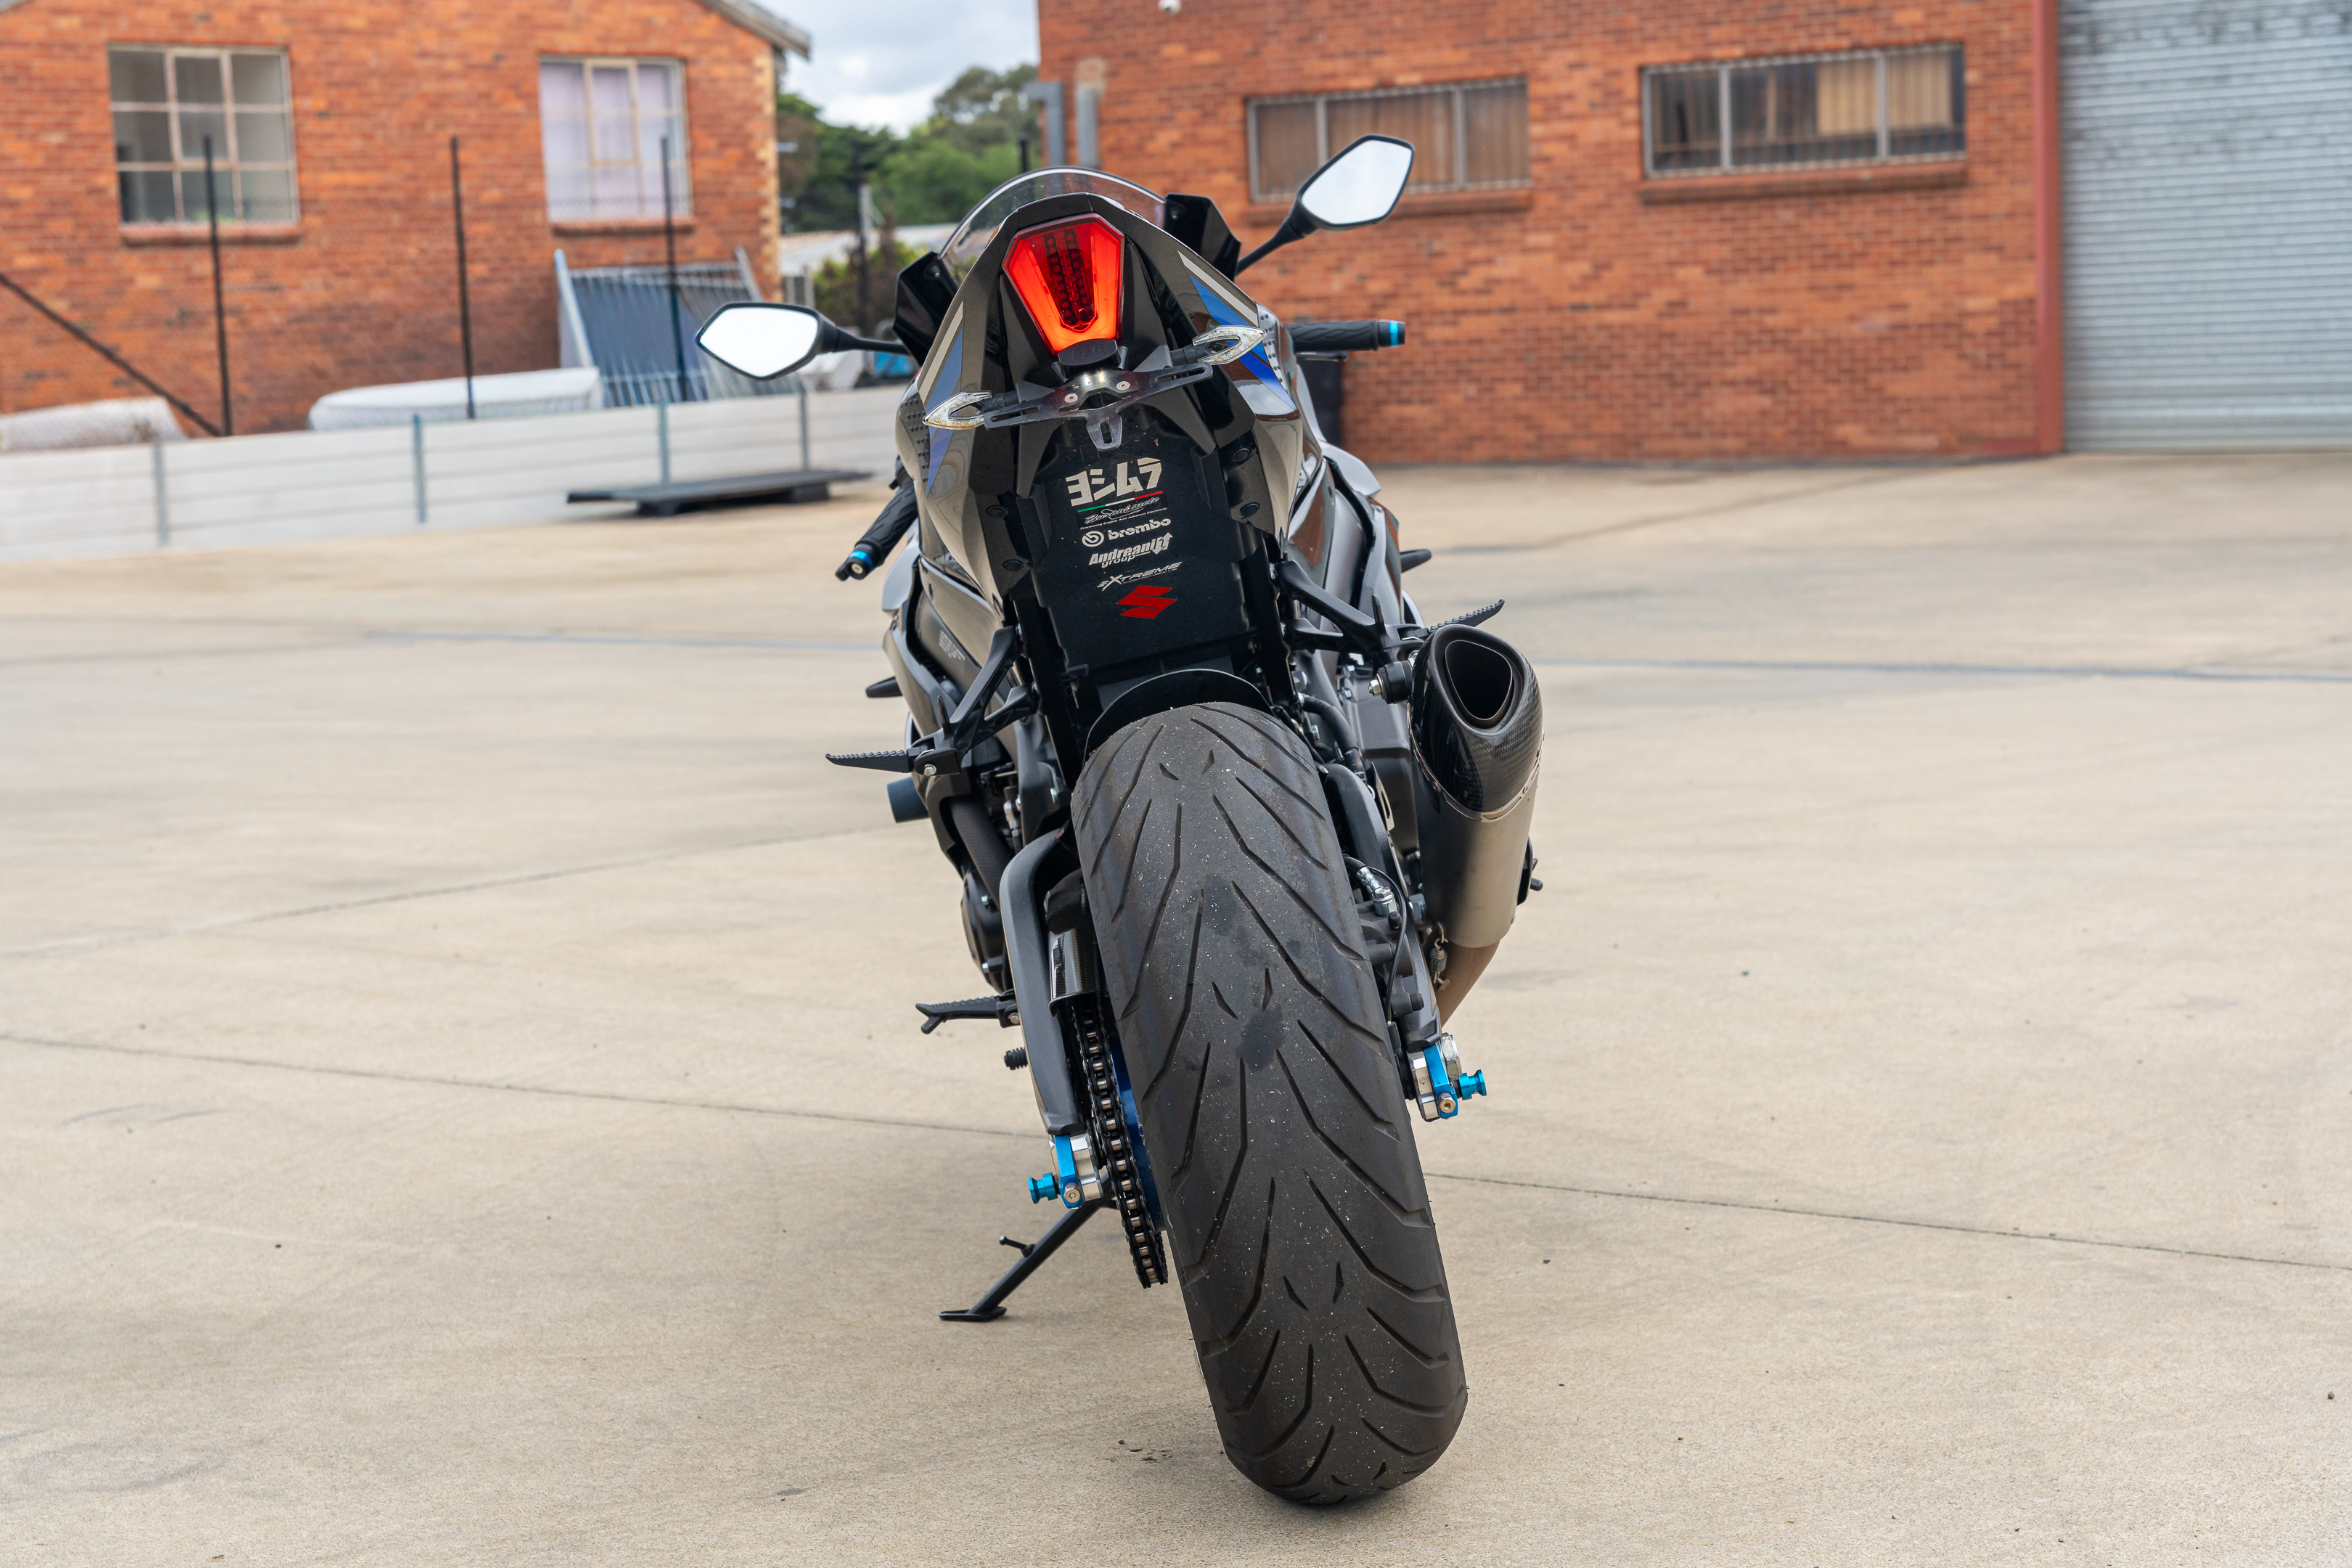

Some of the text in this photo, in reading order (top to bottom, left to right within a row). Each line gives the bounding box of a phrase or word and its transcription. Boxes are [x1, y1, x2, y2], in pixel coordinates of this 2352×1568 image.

[1066, 457, 1161, 506] ヨシムラ
[1108, 518, 1172, 541] brembo
[1089, 539, 1156, 565] Andreani
[1101, 554, 1136, 568] group
